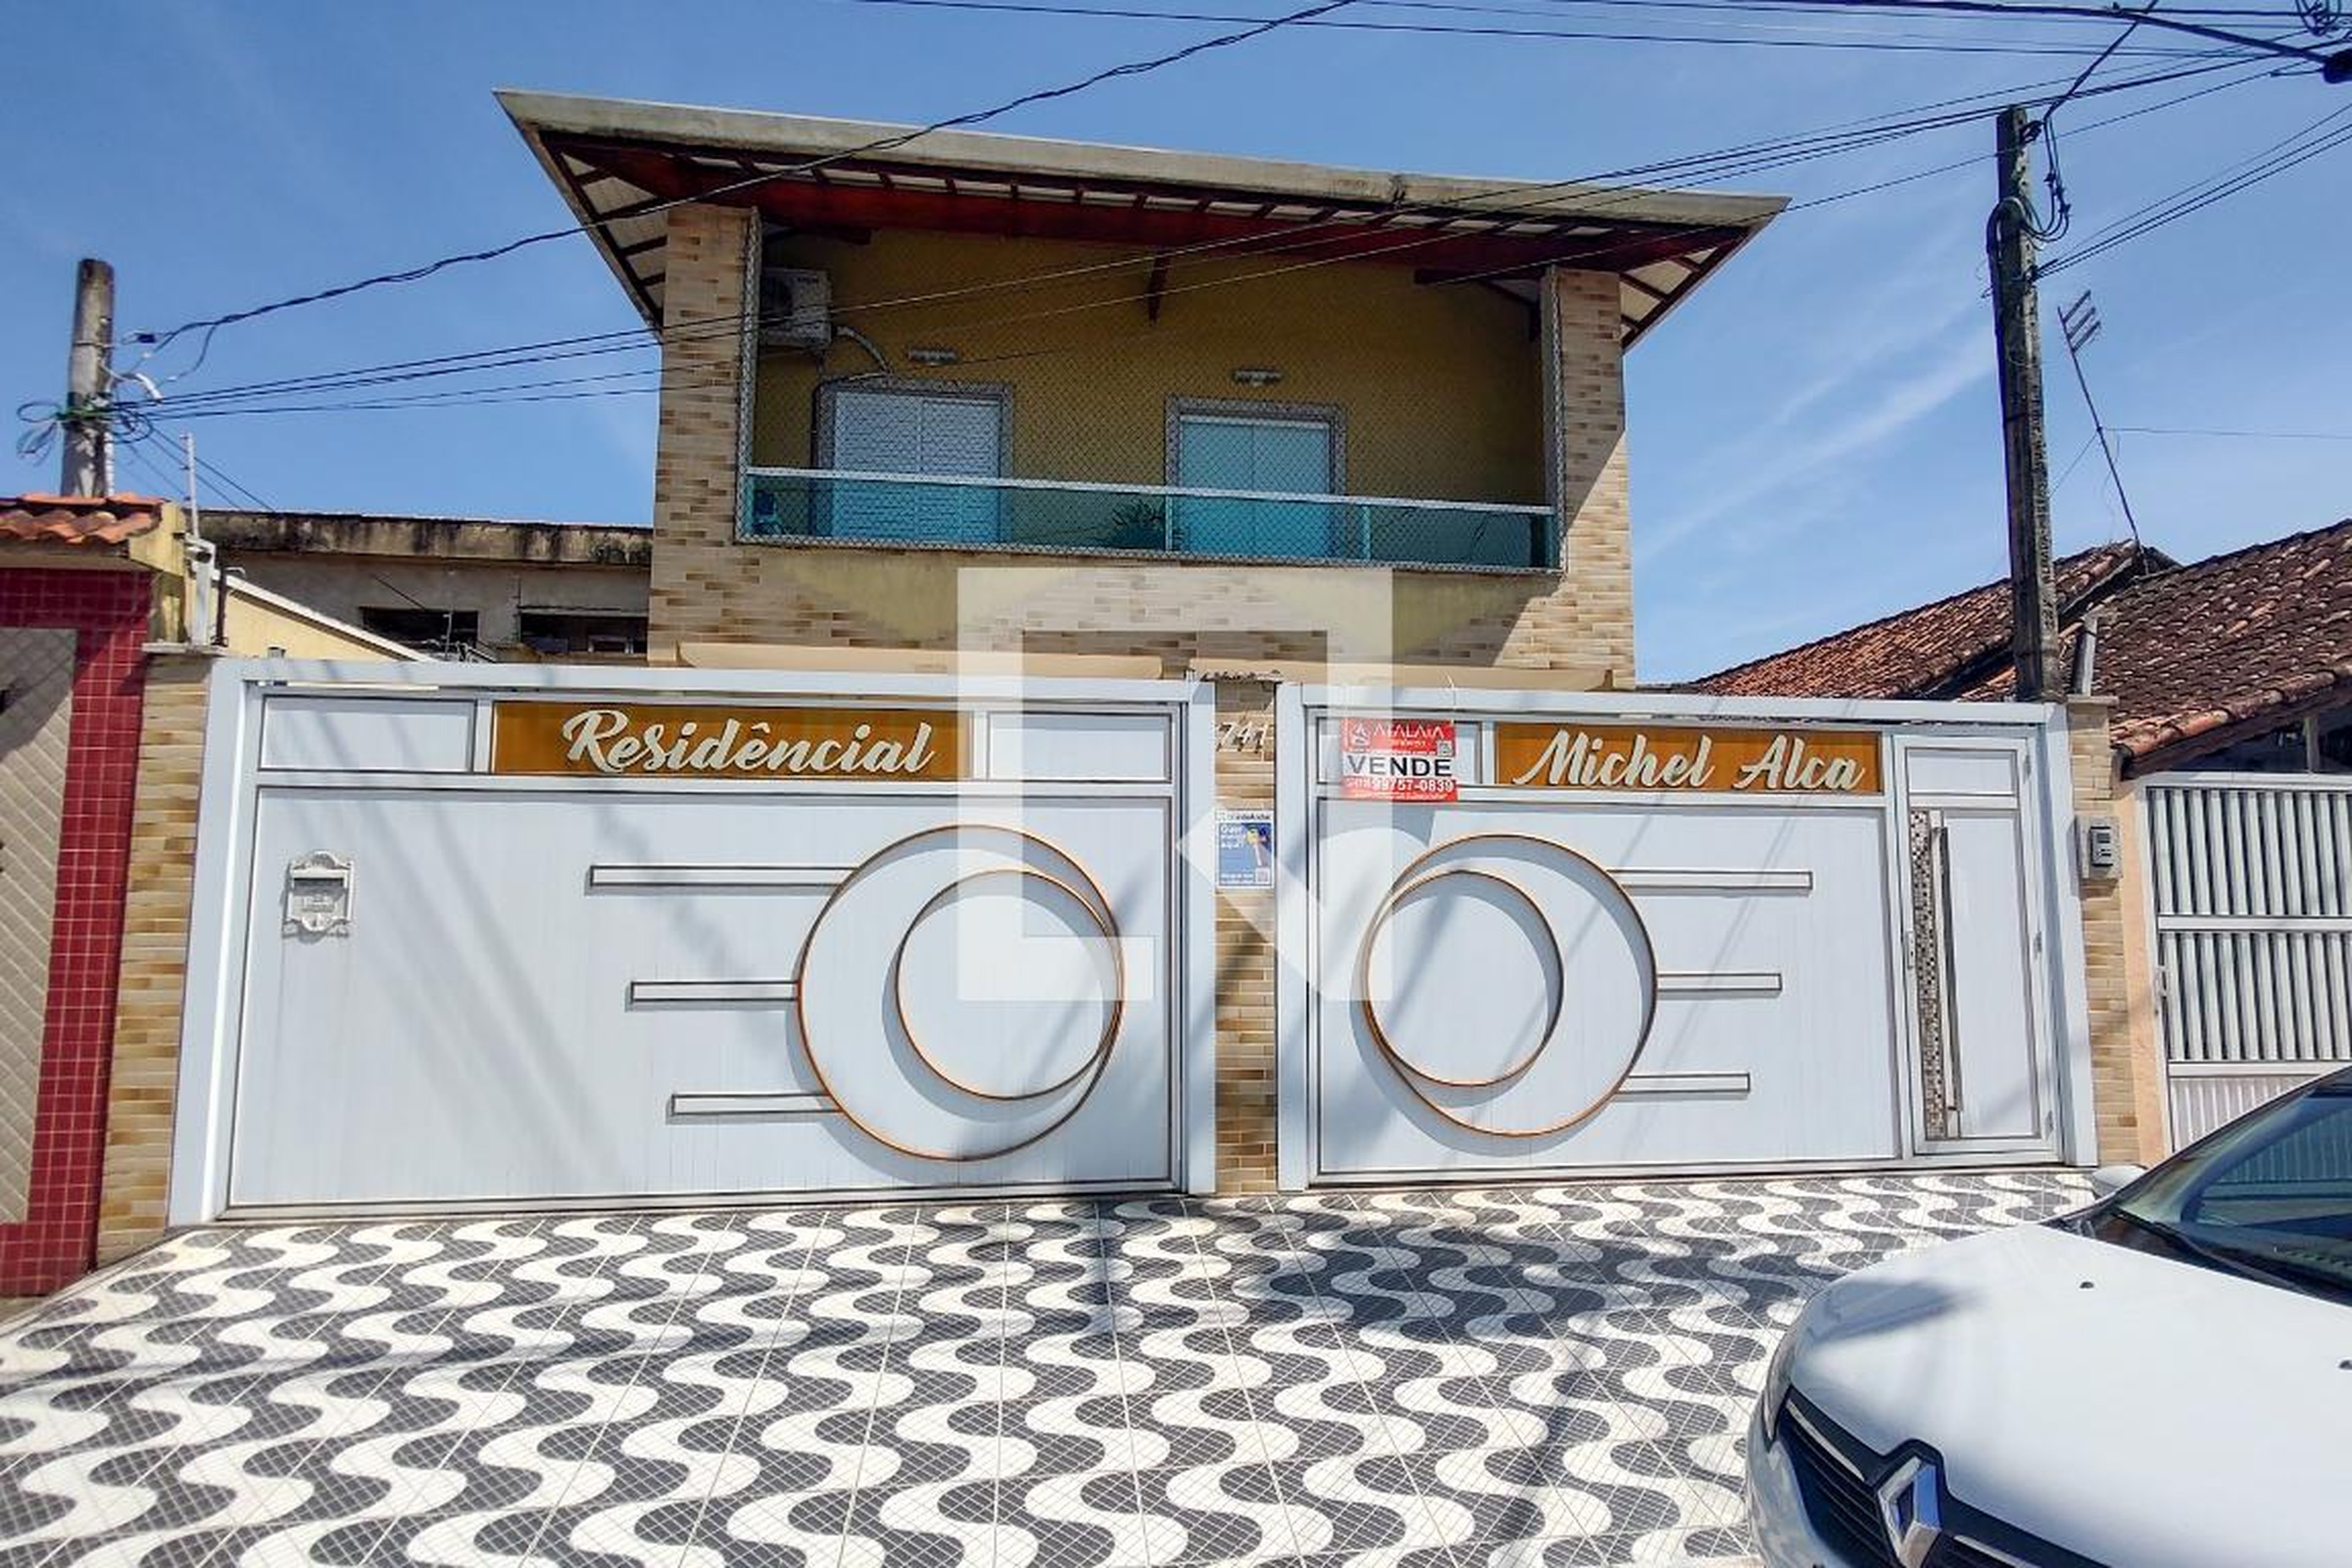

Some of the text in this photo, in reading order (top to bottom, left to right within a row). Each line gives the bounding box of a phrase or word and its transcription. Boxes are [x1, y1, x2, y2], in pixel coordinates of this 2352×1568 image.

[562, 709, 934, 773] Residêncial
[1348, 755, 1453, 777] VENDE
[1512, 728, 1865, 790] Michel Alca
